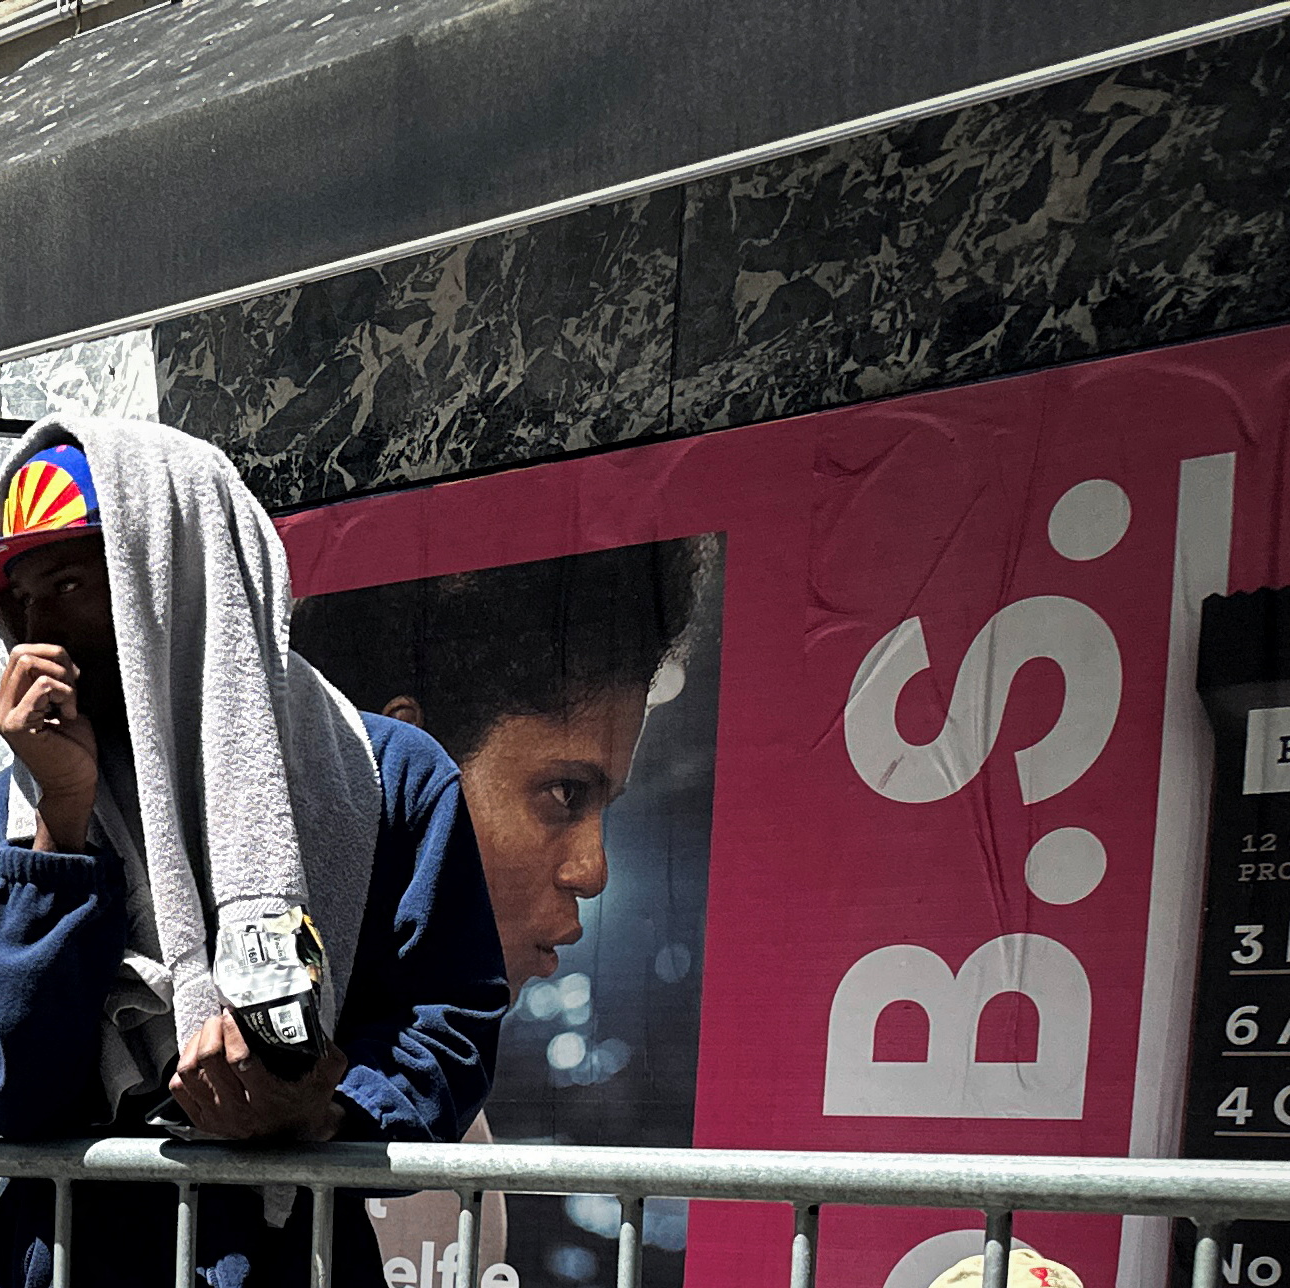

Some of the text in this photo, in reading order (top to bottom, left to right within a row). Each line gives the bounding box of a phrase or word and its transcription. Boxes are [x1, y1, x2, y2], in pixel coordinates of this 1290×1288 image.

[1241, 833, 1278, 853] 12
[1231, 924, 1265, 965] 3
[1225, 1005, 1261, 1046] 6
[1216, 1086, 1254, 1125] 4
[1221, 1243, 1282, 1288] No
